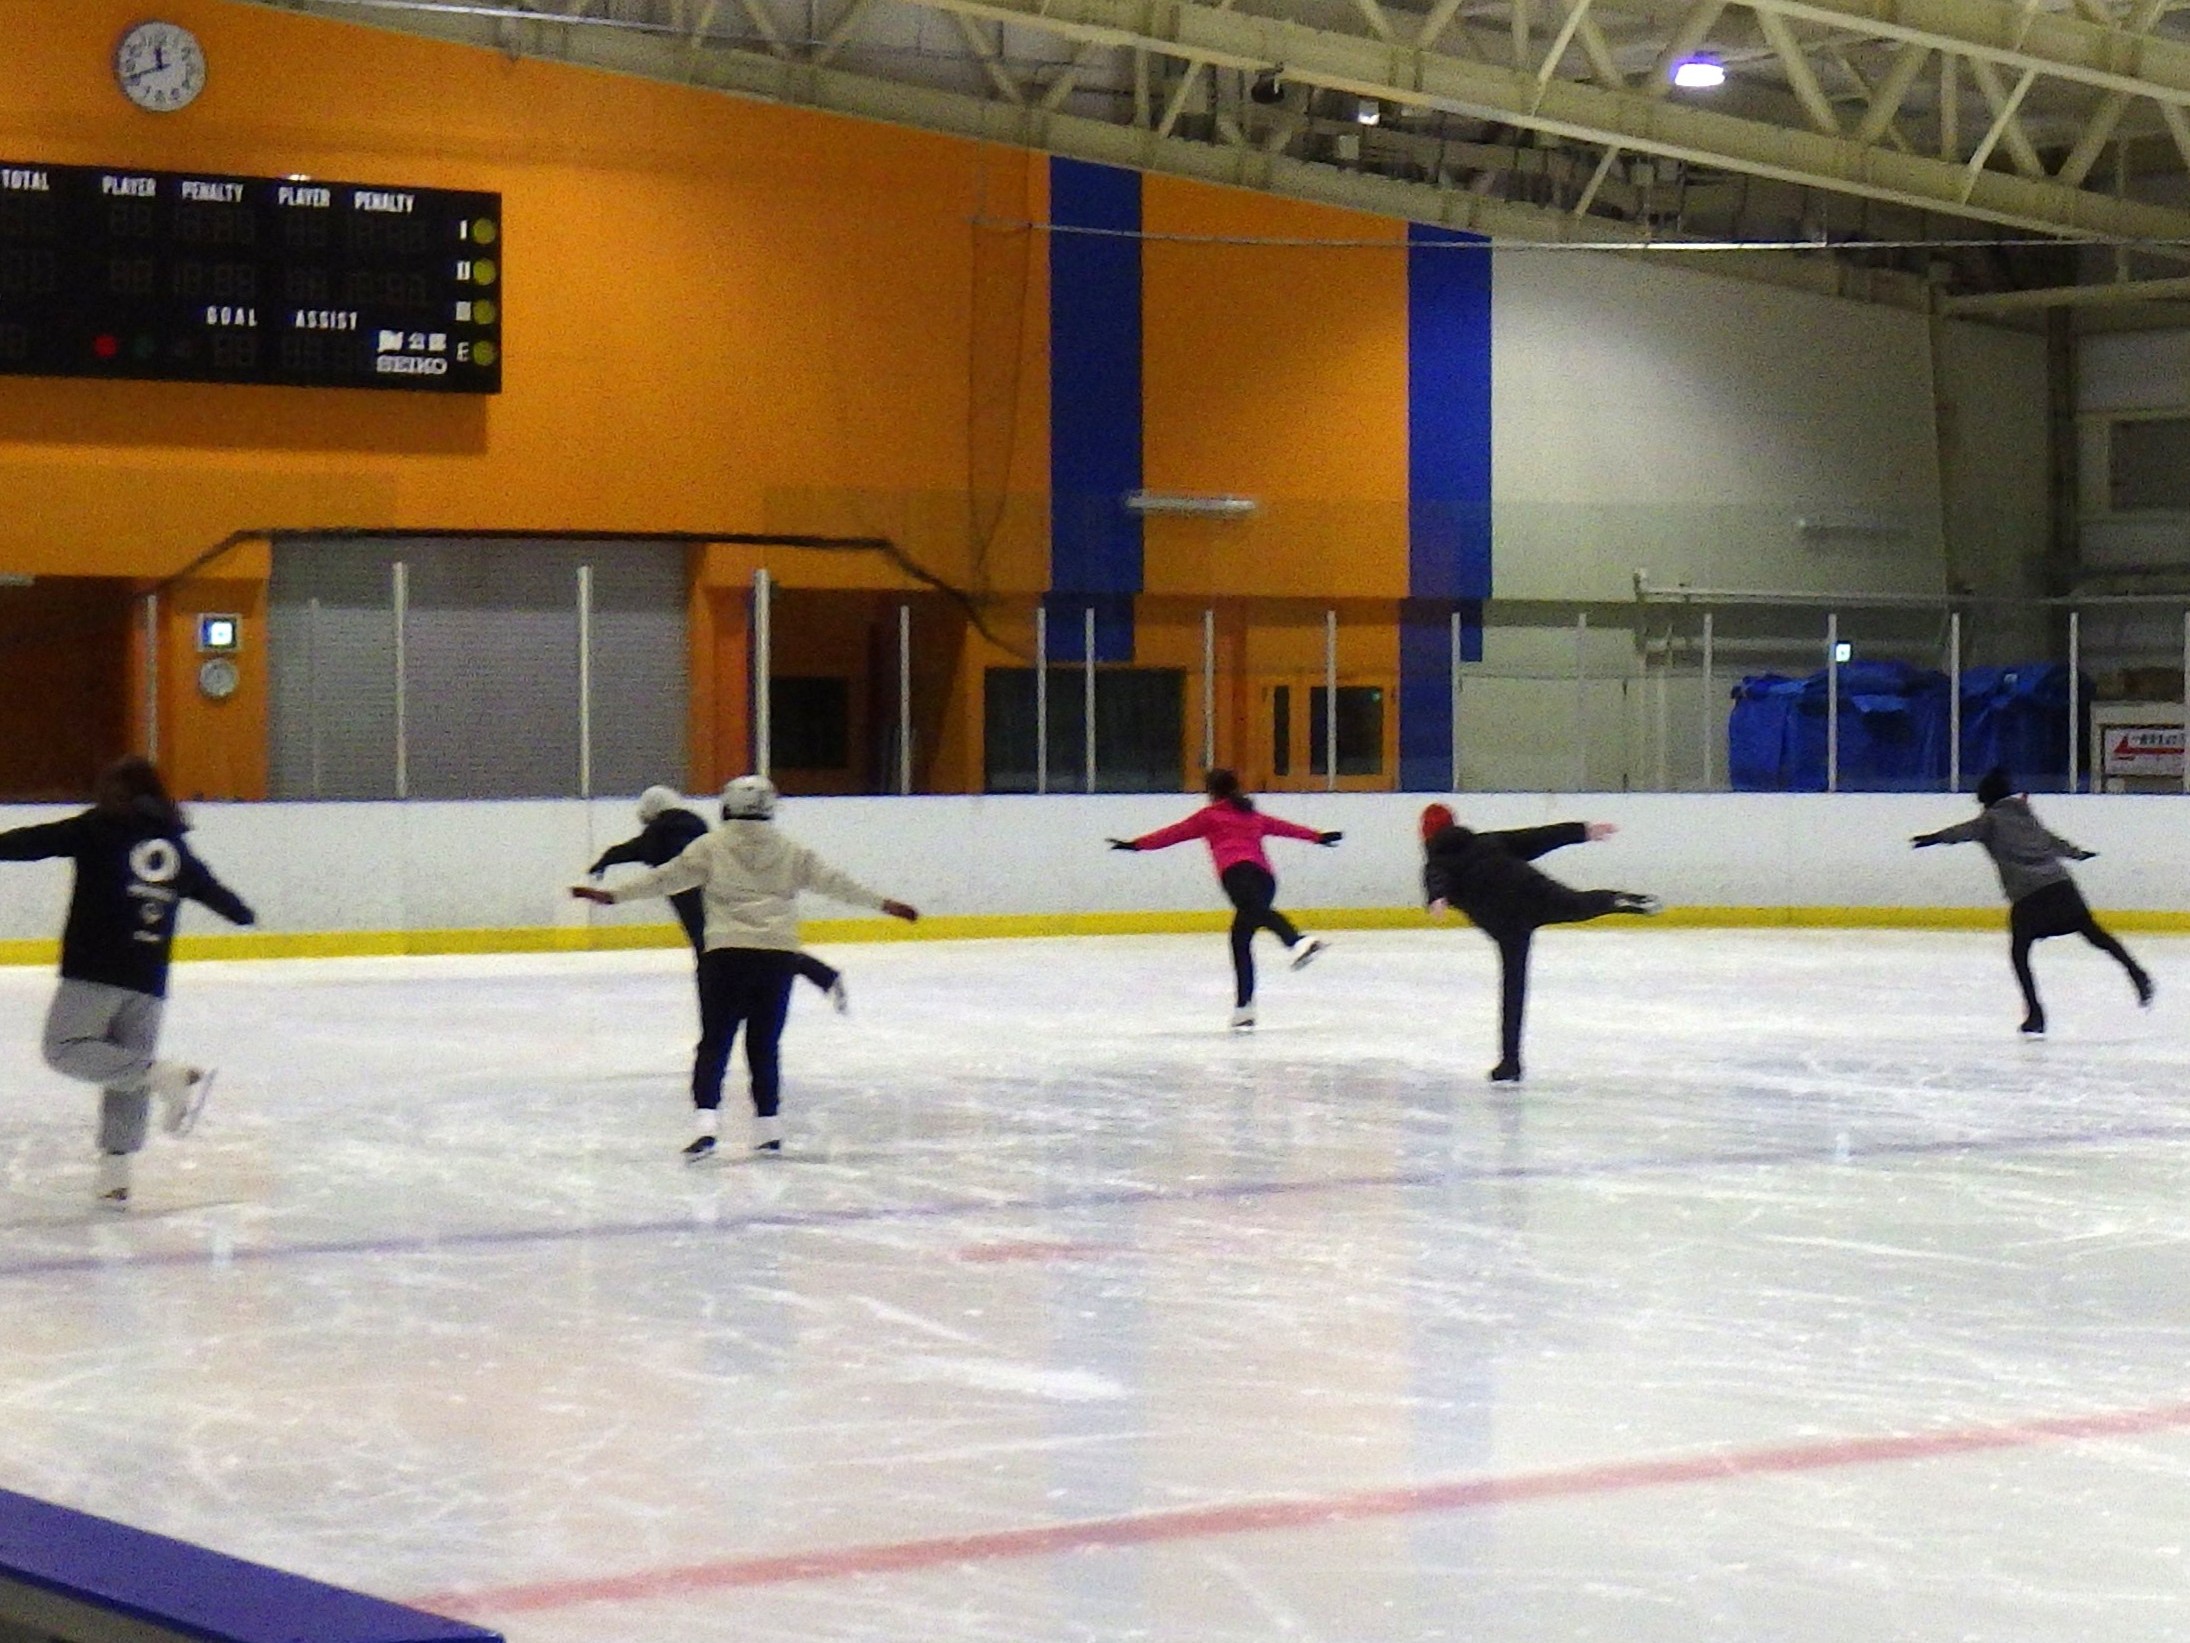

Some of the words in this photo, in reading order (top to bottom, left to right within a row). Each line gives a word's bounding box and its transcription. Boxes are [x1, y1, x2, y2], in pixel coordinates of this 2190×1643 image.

[2, 168, 49, 190] TOTAL
[102, 175, 156, 197] PLAYER
[182, 181, 243, 202] PENALTY
[278, 186, 330, 208] PLAYER
[354, 191, 415, 214] PENALTY
[206, 305, 257, 327] GOAL
[295, 309, 358, 331] ASSIST
